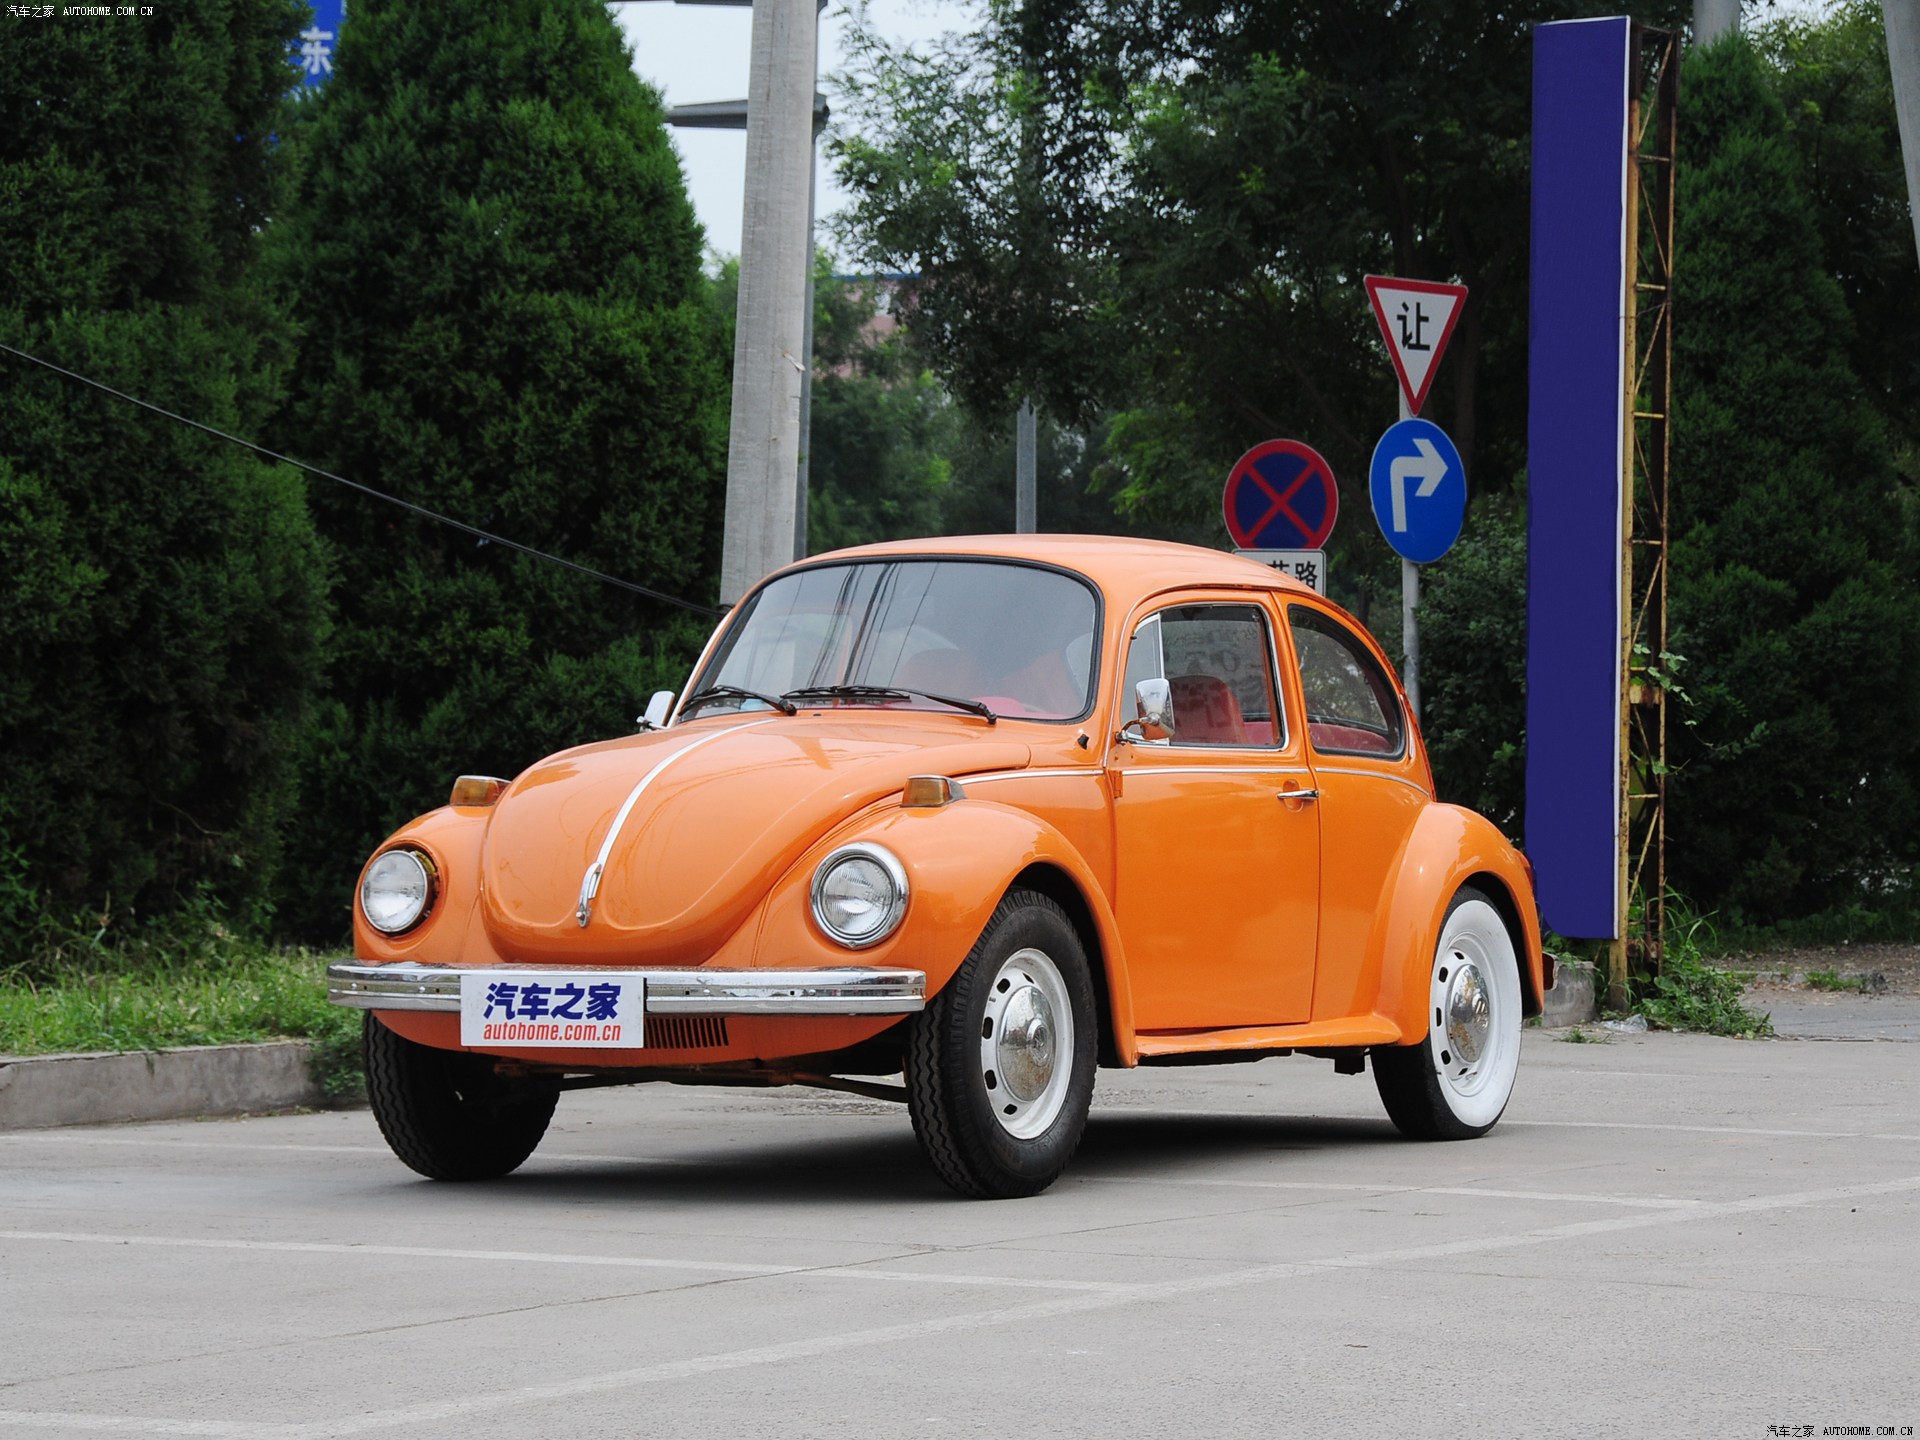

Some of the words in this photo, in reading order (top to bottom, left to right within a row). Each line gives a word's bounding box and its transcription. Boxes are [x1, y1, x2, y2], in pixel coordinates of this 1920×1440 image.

[1396, 301, 1431, 351] 让
[483, 982, 622, 1021] 汽车之家
[483, 1021, 622, 1041] autohome.com.cn
